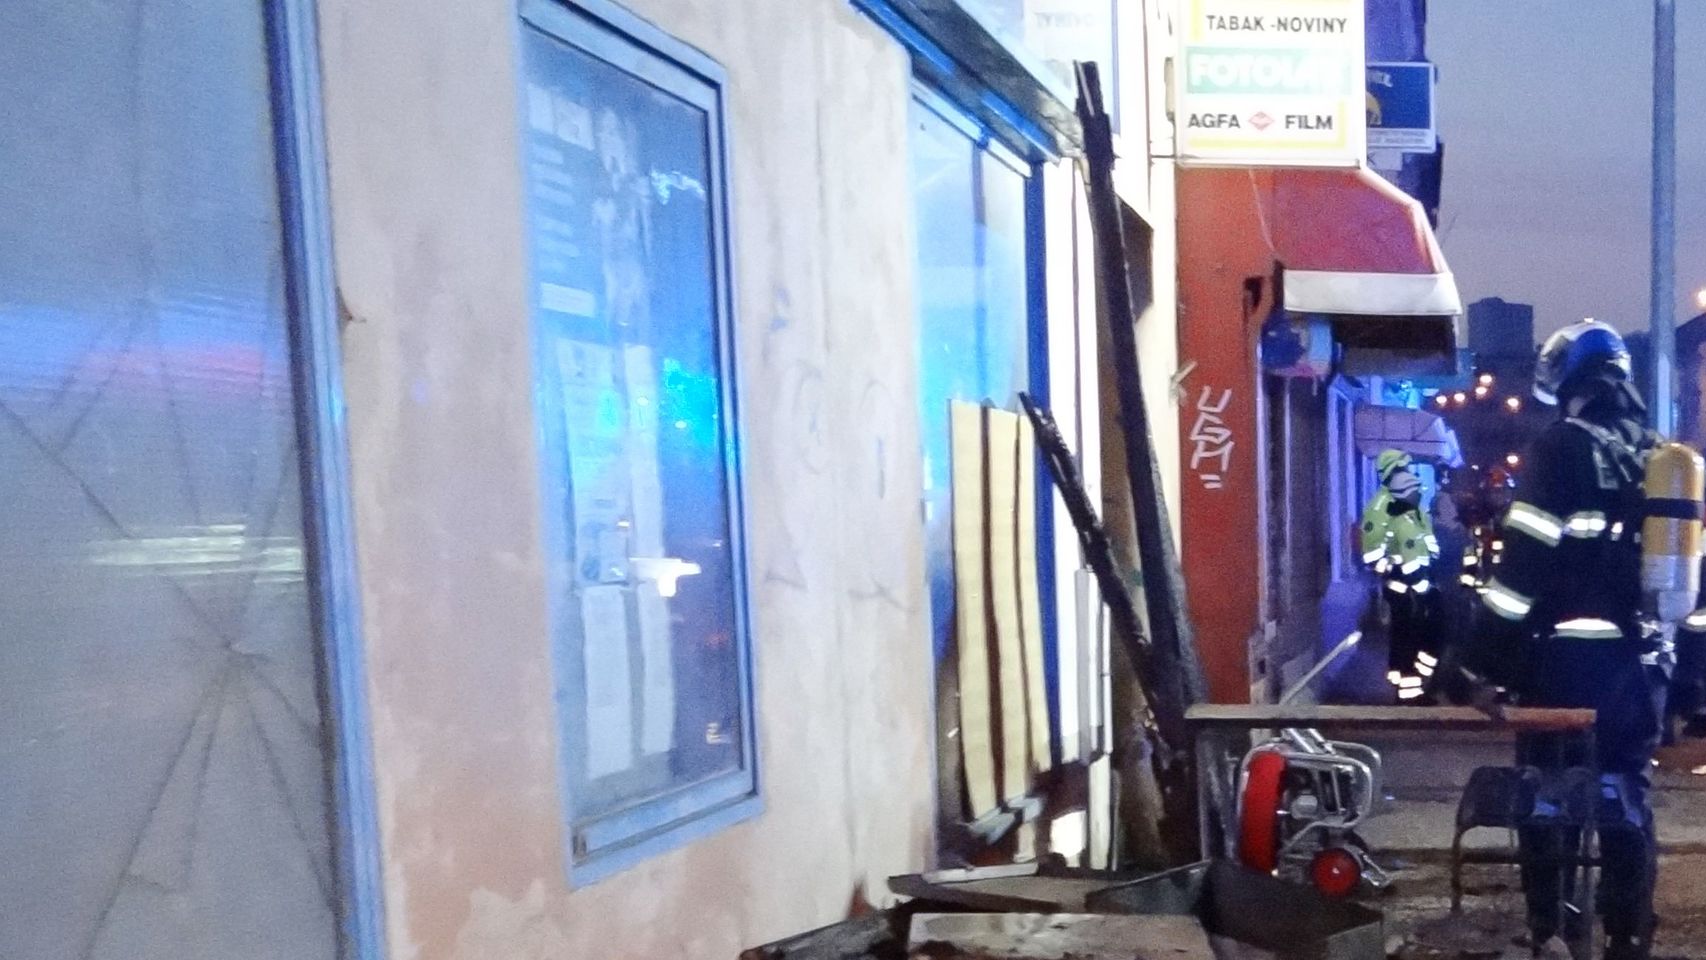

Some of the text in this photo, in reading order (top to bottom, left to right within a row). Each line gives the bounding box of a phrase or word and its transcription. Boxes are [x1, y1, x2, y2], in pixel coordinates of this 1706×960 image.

[1206, 14, 1265, 31] TABAK
[1189, 52, 1346, 91] FOTOLA
[1188, 113, 1333, 130] AGFA FILM
